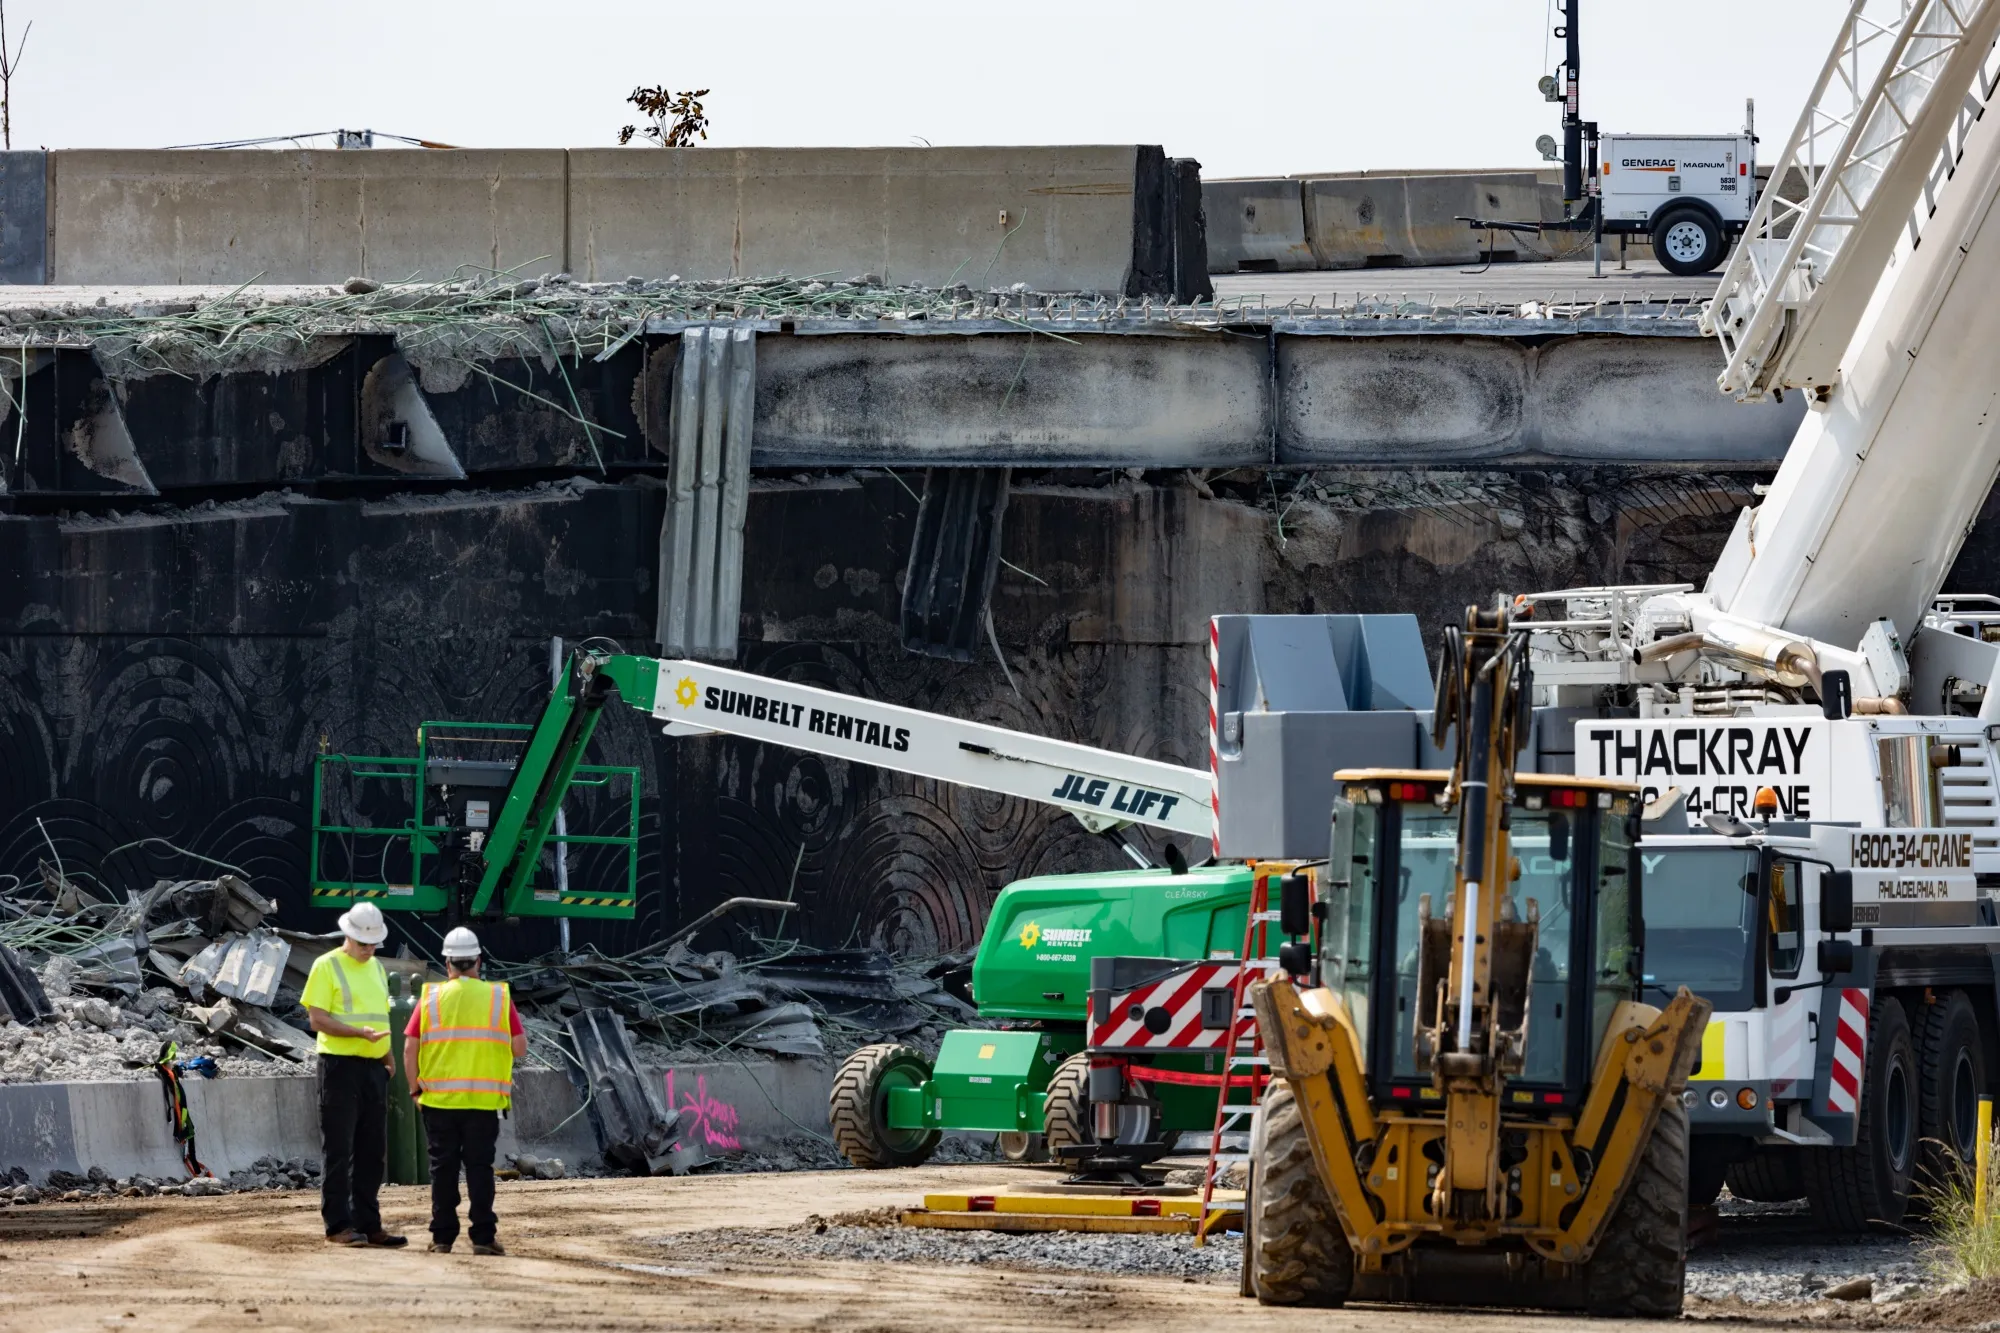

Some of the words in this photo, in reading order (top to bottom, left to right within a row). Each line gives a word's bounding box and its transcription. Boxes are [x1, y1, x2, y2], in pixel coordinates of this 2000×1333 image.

[1622, 159, 1676, 167] GENERAC
[704, 686, 804, 728] SUNBELT
[808, 708, 911, 752] RENTALS
[1590, 727, 1812, 776] THACKRAY
[1052, 774, 1110, 806] JLG
[1110, 785, 1180, 821] LIFT
[1851, 833, 1971, 868] 1-800-34-CRANE
[1164, 887, 1209, 899] CLEARSKY
[1878, 881, 1936, 900] PHILADELPHIA,
[1938, 881, 1948, 899] PA
[1041, 929, 1092, 942] SUNBELT
